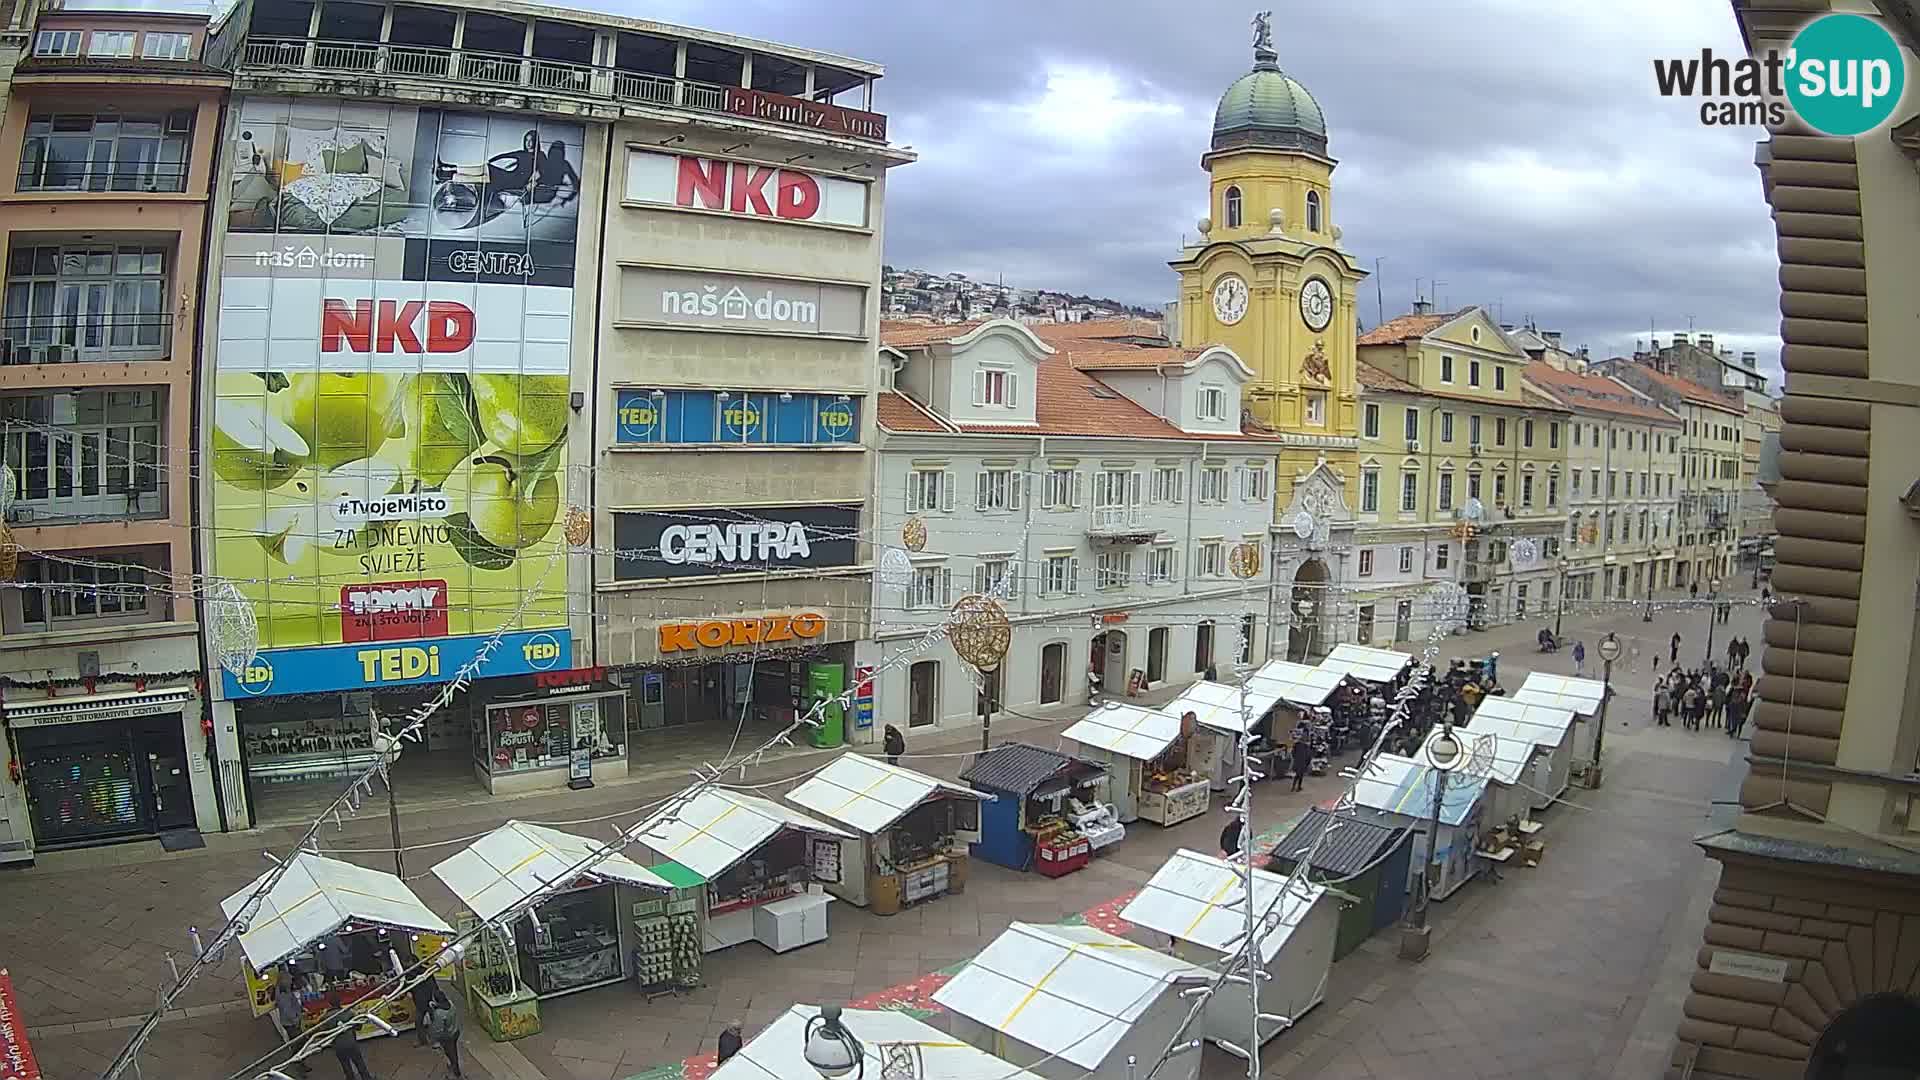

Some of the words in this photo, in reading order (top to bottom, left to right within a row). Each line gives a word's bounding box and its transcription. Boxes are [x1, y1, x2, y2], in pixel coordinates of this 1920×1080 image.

[723, 88, 746, 112] Le
[675, 156, 821, 221] NKD
[255, 244, 295, 269] naš
[319, 248, 366, 270] dom
[447, 250, 535, 277] CENTRA
[661, 284, 718, 317] naš
[754, 292, 817, 324] dom
[321, 298, 477, 355] NKD
[619, 407, 658, 426] TEDi
[723, 408, 760, 426] TEDi
[820, 411, 853, 427] TEDi
[338, 497, 447, 517] #TvojeMisto
[334, 528, 358, 549] ZA
[367, 524, 452, 549] DNEVNO
[659, 520, 812, 565] CENTRA
[360, 547, 427, 575] SVJEŽE
[349, 587, 440, 615] TOMMY
[380, 613, 400, 626] ŠTO
[659, 612, 826, 653] KORZO
[358, 646, 440, 683] TEDi
[523, 643, 560, 661] TEDi
[237, 664, 274, 683] EDi
[76, 709, 129, 722] INFORMATIVNI
[132, 704, 163, 716] CENTAR
